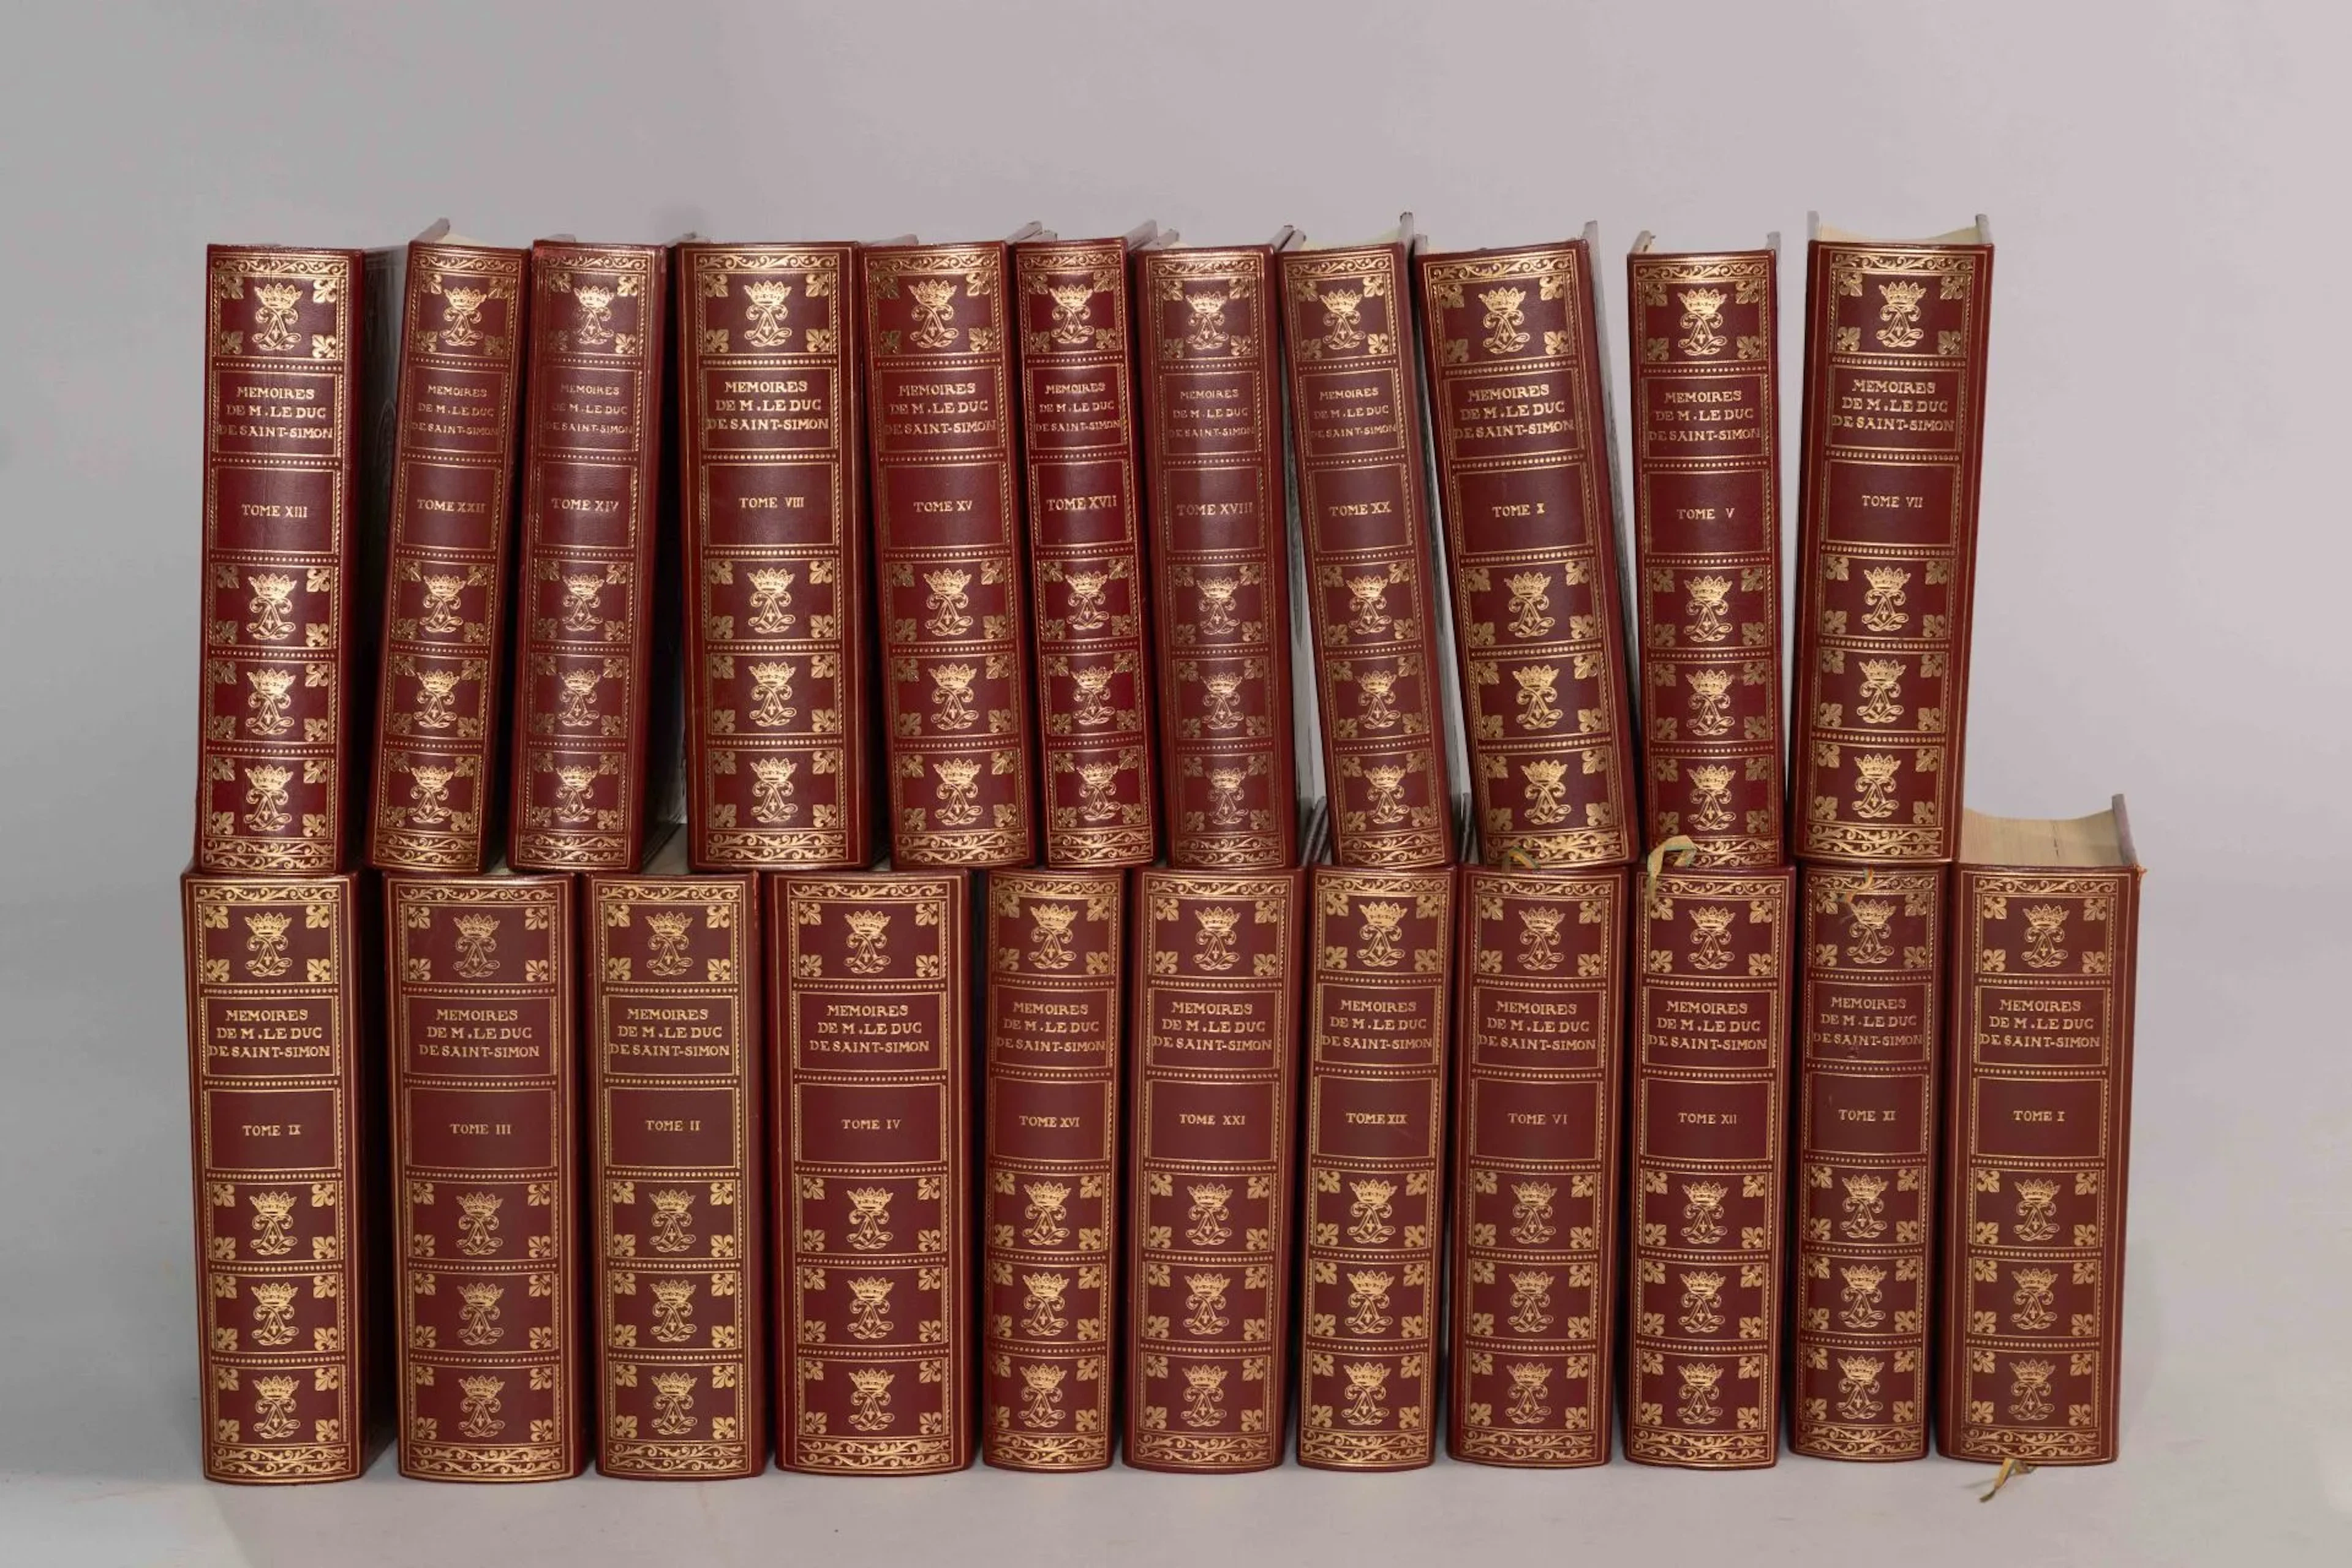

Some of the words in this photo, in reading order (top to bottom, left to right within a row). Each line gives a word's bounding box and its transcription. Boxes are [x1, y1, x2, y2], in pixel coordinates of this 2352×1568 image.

[237, 386, 315, 400] MEMOIRES
[428, 385, 488, 398] MEMOIRES
[562, 385, 620, 396] MEMOIRES
[725, 380, 808, 393] MEMOIRES
[899, 383, 976, 396] MEMOIRES
[1044, 382, 1106, 394] MEMOIRES
[1469, 384, 1550, 401] MEMOIRES
[1852, 379, 1936, 394] MEMOIRES
[1180, 388, 1239, 399] MEMOIRES
[1320, 387, 1379, 400] MEMOIRES
[1665, 390, 1742, 403] MEMOIRES
[715, 399, 736, 412] DE
[788, 399, 821, 412] DUC
[1460, 407, 1483, 421] DE
[1532, 401, 1565, 416] DUC
[1841, 396, 1863, 410] DE
[1915, 400, 1948, 413] DUC
[226, 404, 246, 416] DE
[295, 407, 326, 419] DUC
[730, 418, 829, 431] SAINT-SIMON
[1476, 420, 1574, 438] SAINT-SIMON
[1856, 417, 1954, 431] SAINT-SIMON
[239, 426, 333, 439] SAINT-SIMON
[417, 499, 454, 512] TOME
[456, 502, 485, 513] XXII
[551, 499, 591, 511] TOME
[594, 500, 619, 513] XIV
[739, 497, 778, 508] TOME
[785, 497, 804, 508] VIII
[913, 500, 953, 513] TOME
[956, 500, 973, 511] XV
[1047, 497, 1086, 511] TOME
[1088, 496, 1117, 509] XVII
[1861, 495, 1900, 508] TOME
[1905, 496, 1923, 508] VII
[241, 504, 281, 517] TOME
[285, 505, 307, 518] XIII
[1177, 503, 1216, 516] TOME
[1219, 502, 1253, 515] XVIII
[1330, 503, 1368, 516] TOME
[1370, 502, 1392, 514] XX
[1491, 504, 1531, 518] TOME
[1536, 503, 1545, 514] X
[1677, 508, 1716, 520] TOME
[1725, 507, 1735, 518] V
[1013, 1002, 1088, 1016] MEMOIRES
[1171, 1001, 1253, 1016] MEMOIRES
[1340, 1000, 1417, 1013] MEMOIRES
[1496, 1001, 1577, 1016] MEMOIRES
[1666, 1001, 1748, 1015] MEMOIRES
[1831, 997, 1907, 1010] MEMOIRES
[1999, 999, 2081, 1012] MEMOIRES
[225, 1009, 308, 1022] MEMOIRES
[436, 1009, 518, 1022] MEMOIRES
[627, 1008, 709, 1021] MEMOIRES
[826, 1005, 908, 1017] MEMOIRES
[817, 1022, 839, 1034] DE
[890, 1022, 922, 1035] DUC
[1003, 1018, 1022, 1030] DE
[1069, 1021, 1099, 1033] DUC
[1161, 1018, 1182, 1031] DE
[1234, 1021, 1265, 1033] DUC
[1330, 1016, 1349, 1028] DE
[1397, 1019, 1427, 1031] DUC
[1487, 1017, 1507, 1030] DE
[1558, 1021, 1589, 1033] DUC
[1657, 1017, 1677, 1030] DE
[1728, 1020, 1761, 1033] DUC
[1989, 1016, 2010, 1028] DE
[2062, 1018, 2094, 1030] DUC
[216, 1027, 237, 1039] DE
[290, 1027, 322, 1040] DUC
[427, 1026, 448, 1038] DE
[499, 1027, 532, 1040] DUC
[617, 1025, 638, 1038] DE
[690, 1026, 722, 1039] DUC
[832, 1041, 929, 1053] SAINT-SIMON
[1016, 1039, 1106, 1052] SAINT-SIMON
[1175, 1038, 1272, 1051] SAINT-SIMON
[1342, 1037, 1433, 1050] SAINT-SIMON
[1500, 1037, 1596, 1051] SAINT-SIMON
[1670, 1036, 1767, 1050] SAINT-SIMON
[2003, 1035, 2100, 1048] SAINT-SIMON
[231, 1046, 330, 1058] SAINT-SIMON
[441, 1046, 540, 1058] SAINT-SIMON
[632, 1044, 730, 1057] SAINT-SIMON
[1019, 1115, 1057, 1128] TOME
[1060, 1117, 1080, 1128] XVI
[1179, 1114, 1216, 1125] TOME
[1223, 1115, 1245, 1126] XXI
[1346, 1112, 1385, 1125] TOME
[1387, 1114, 1407, 1125] XIX
[1508, 1113, 1546, 1125] TOME
[1552, 1114, 1568, 1125] VI
[1678, 1112, 1716, 1125] TOME
[1721, 1114, 1737, 1125] XII
[1838, 1109, 1876, 1122] TOME
[1882, 1110, 1896, 1121] XI
[2013, 1110, 2052, 1121] TOME
[2057, 1110, 2065, 1122] I
[242, 1125, 281, 1137] TOME
[288, 1124, 301, 1136] IX
[450, 1123, 489, 1135] TOME
[496, 1124, 511, 1135] III
[646, 1120, 683, 1131] TOME
[690, 1120, 701, 1131] II
[842, 1119, 880, 1130] TOME
[886, 1119, 901, 1129] IV
